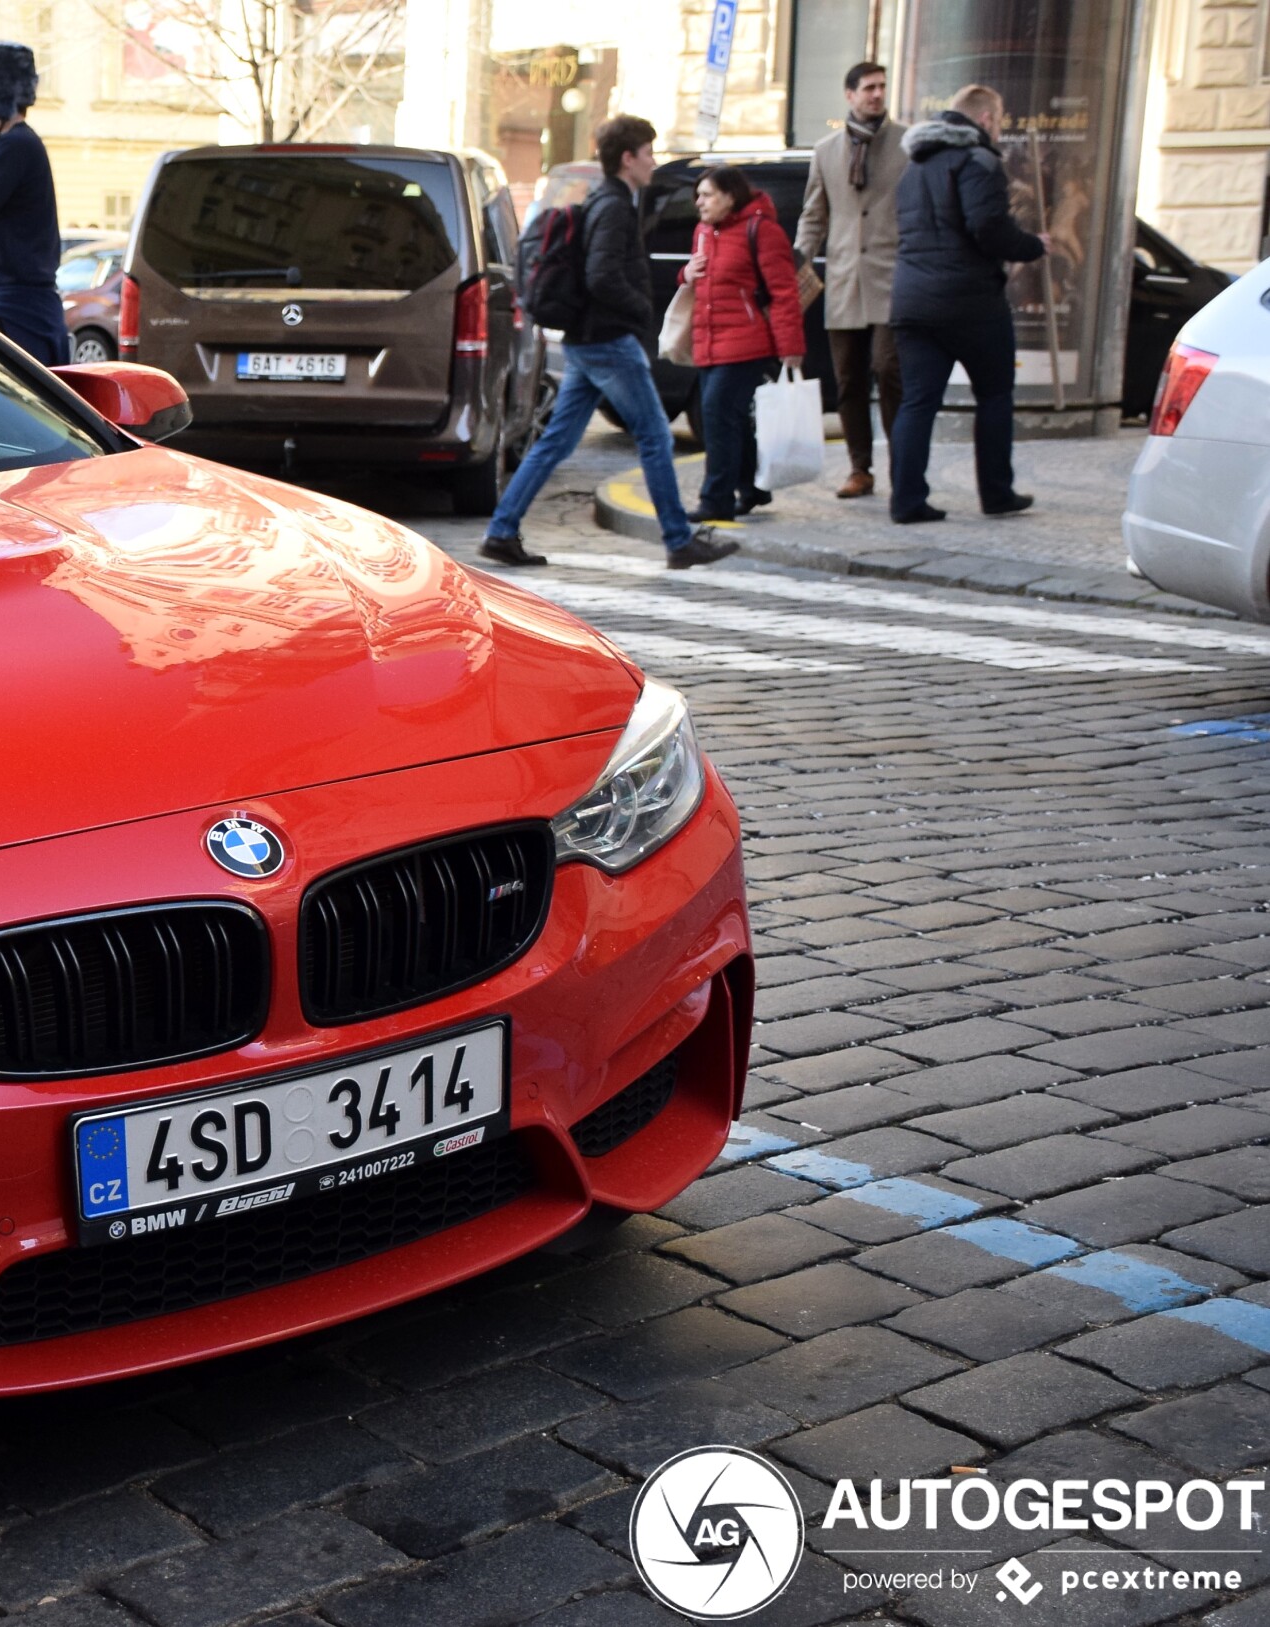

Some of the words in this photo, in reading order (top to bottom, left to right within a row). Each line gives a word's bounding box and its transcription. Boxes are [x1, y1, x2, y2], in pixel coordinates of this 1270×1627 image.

[252, 356, 281, 372] 6AT
[296, 357, 336, 373] 4616
[210, 820, 266, 842] BMW
[145, 1099, 271, 1191] 4SD
[327, 1045, 474, 1150] 3414
[445, 1131, 479, 1152] Castrol
[338, 1151, 415, 1186] 241007222
[89, 1178, 122, 1205] CZ
[131, 1209, 186, 1236] BMW
